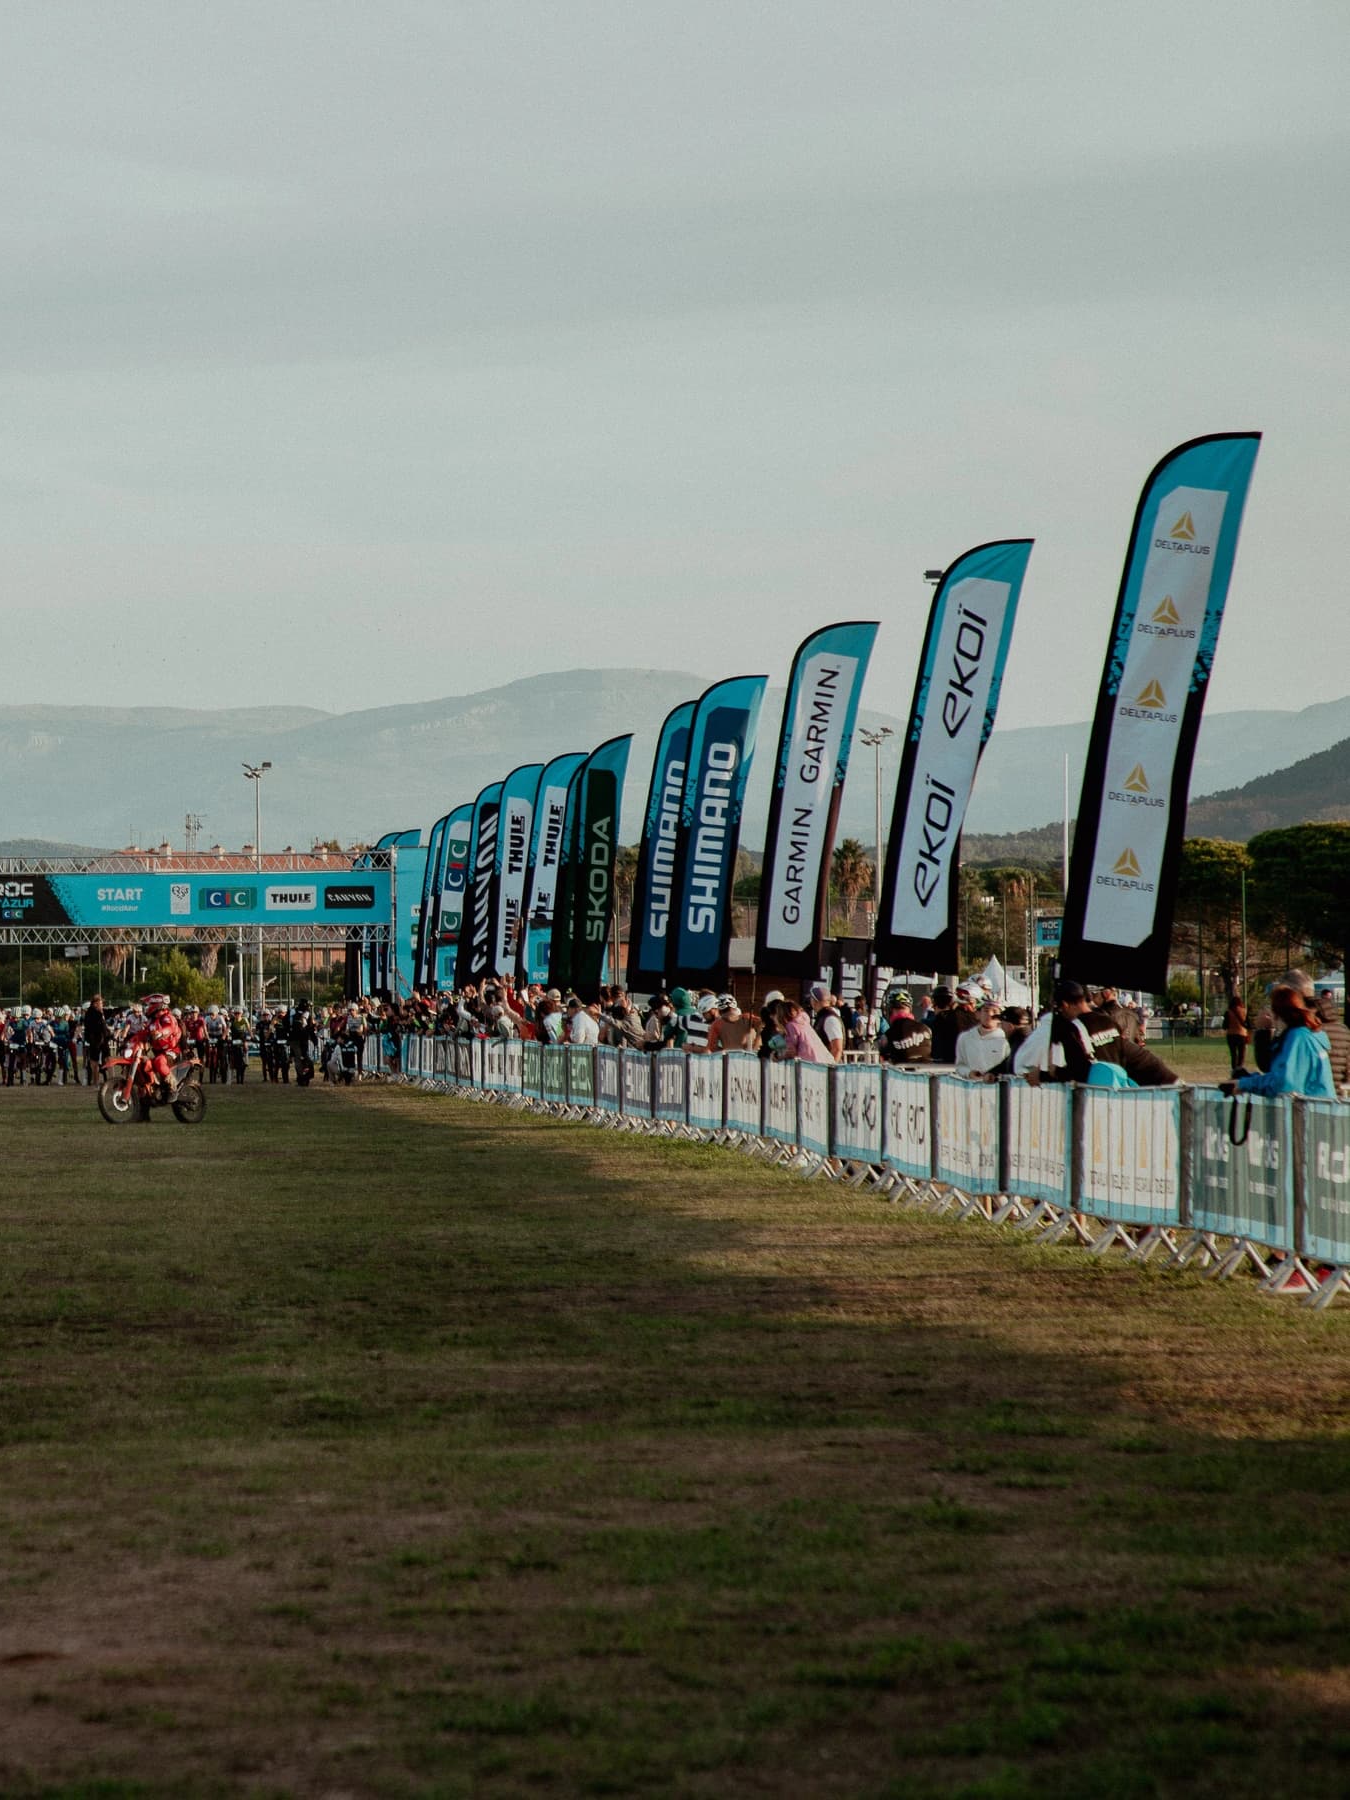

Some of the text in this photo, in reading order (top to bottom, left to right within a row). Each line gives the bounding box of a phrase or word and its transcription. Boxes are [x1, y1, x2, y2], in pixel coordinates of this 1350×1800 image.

[1154, 538, 1211, 556] DELTAPLUS
[1137, 622, 1197, 640] DELTAPLUS
[1119, 706, 1178, 723] DELTAPLUS
[800, 667, 838, 784] GARMIN
[1107, 791, 1166, 808] DELTAPLUS
[508, 814, 526, 875] THULE
[543, 804, 563, 867] THULE
[687, 742, 737, 934] SHIMANO
[448, 843, 467, 887] CIC
[782, 806, 811, 926] GARMIN
[1096, 874, 1155, 893] DELTAPLUS
[97, 887, 143, 901] START
[210, 892, 246, 906] CIC
[271, 893, 312, 904] THULE
[327, 892, 372, 902] CANYON
